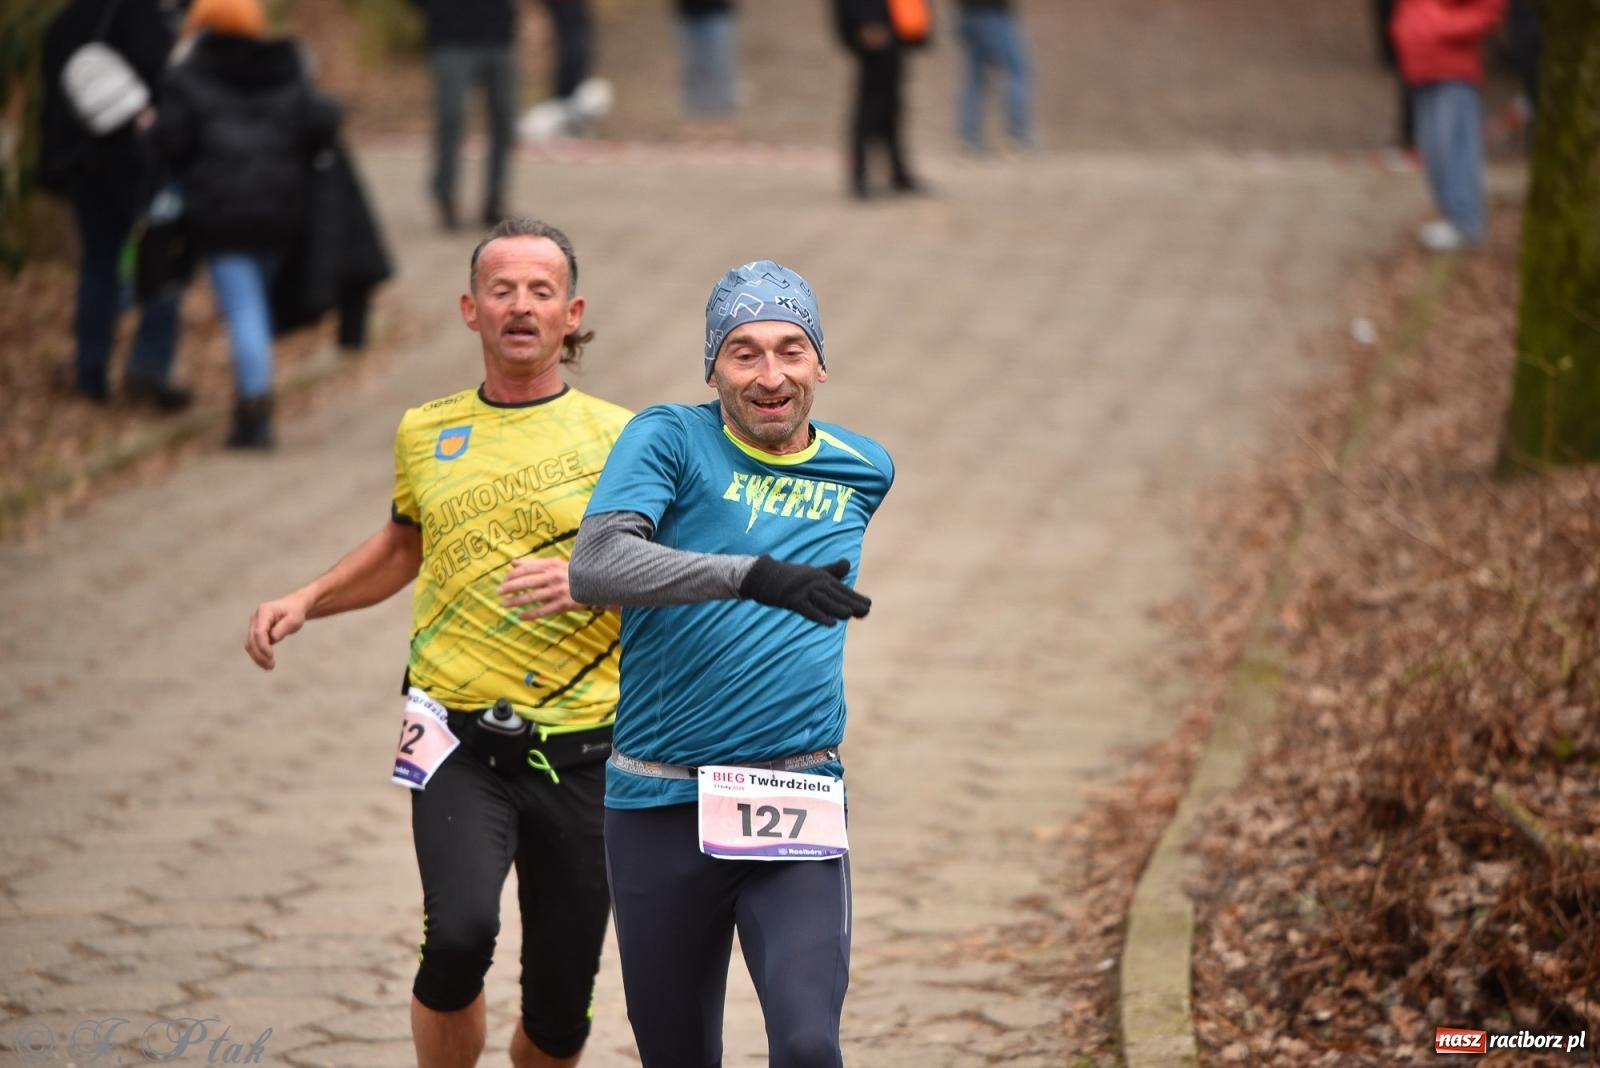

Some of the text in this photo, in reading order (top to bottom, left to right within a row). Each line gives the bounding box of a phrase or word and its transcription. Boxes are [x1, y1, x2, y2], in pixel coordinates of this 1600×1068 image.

[424, 450, 583, 556] EJKOWICE
[723, 471, 857, 534] ENERGY
[431, 500, 558, 589] BIEGAJĄ
[398, 719, 425, 756] 2
[713, 771, 831, 793] BIEG Twardziela
[736, 802, 808, 839] 127
